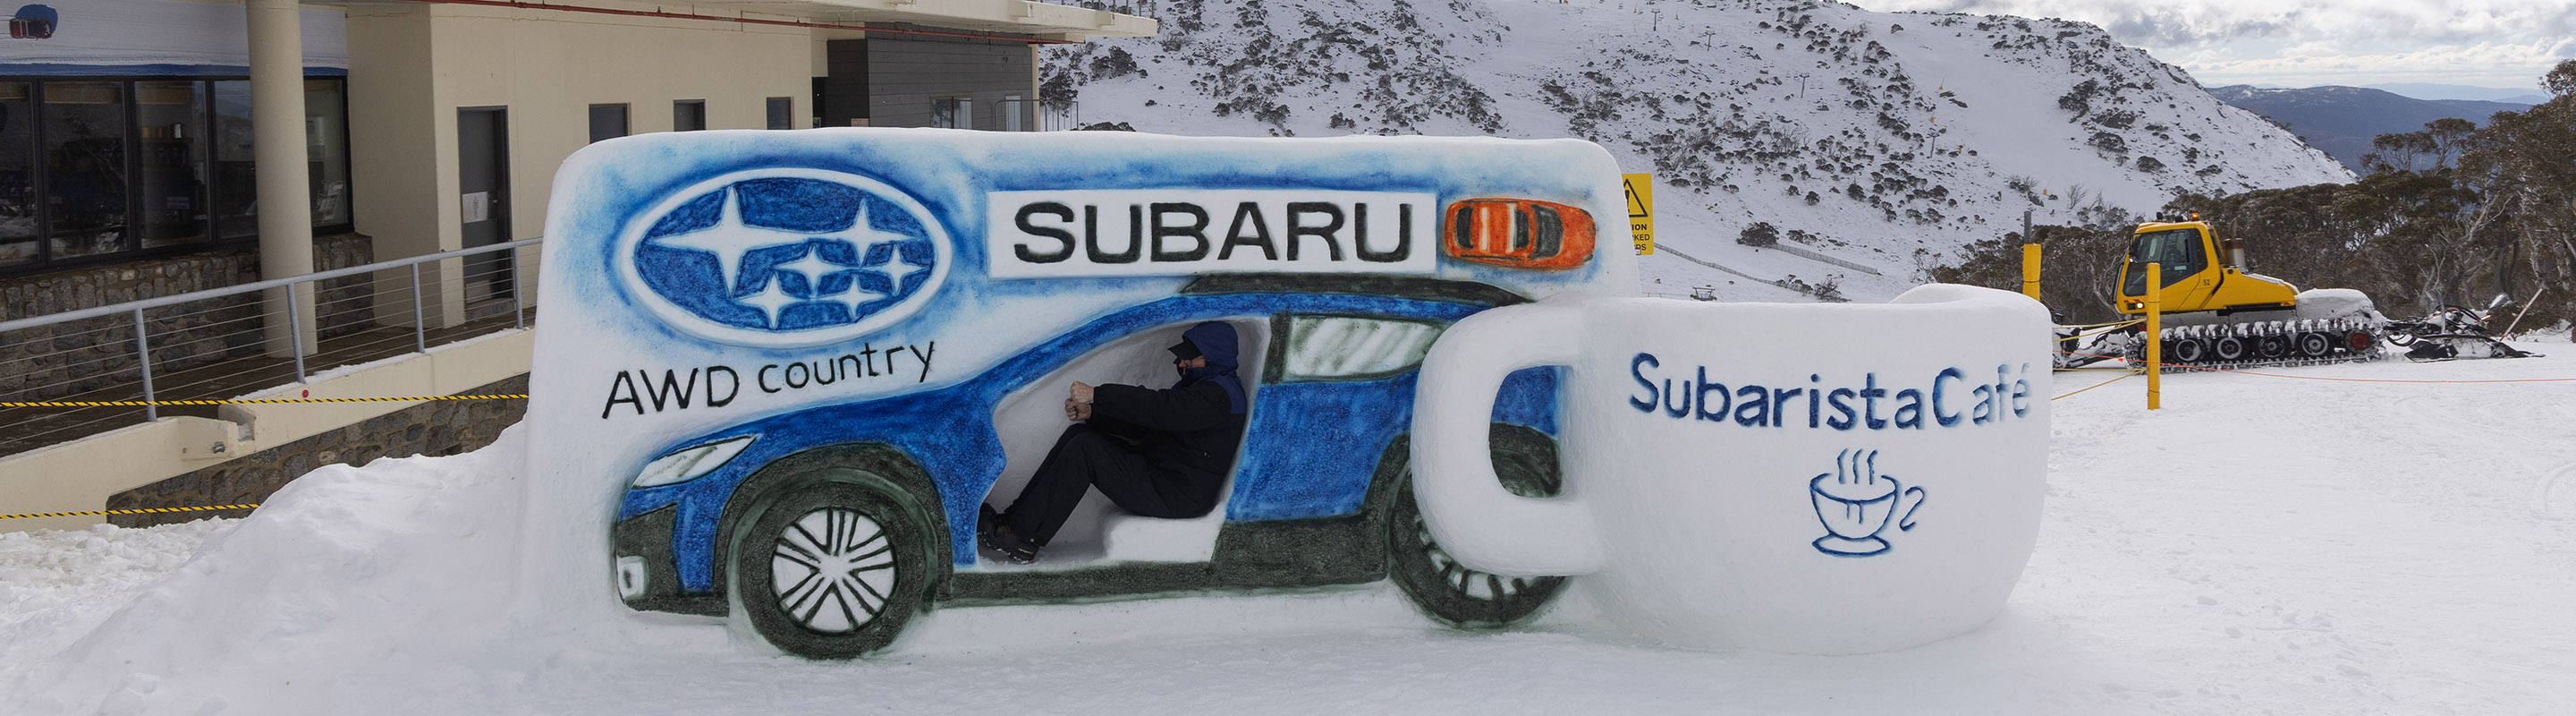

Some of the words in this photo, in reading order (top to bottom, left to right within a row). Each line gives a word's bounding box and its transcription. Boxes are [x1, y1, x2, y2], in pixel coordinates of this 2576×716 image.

[1013, 200, 1412, 264] SUBARU
[601, 364, 741, 421] AWD
[757, 340, 935, 394] country
